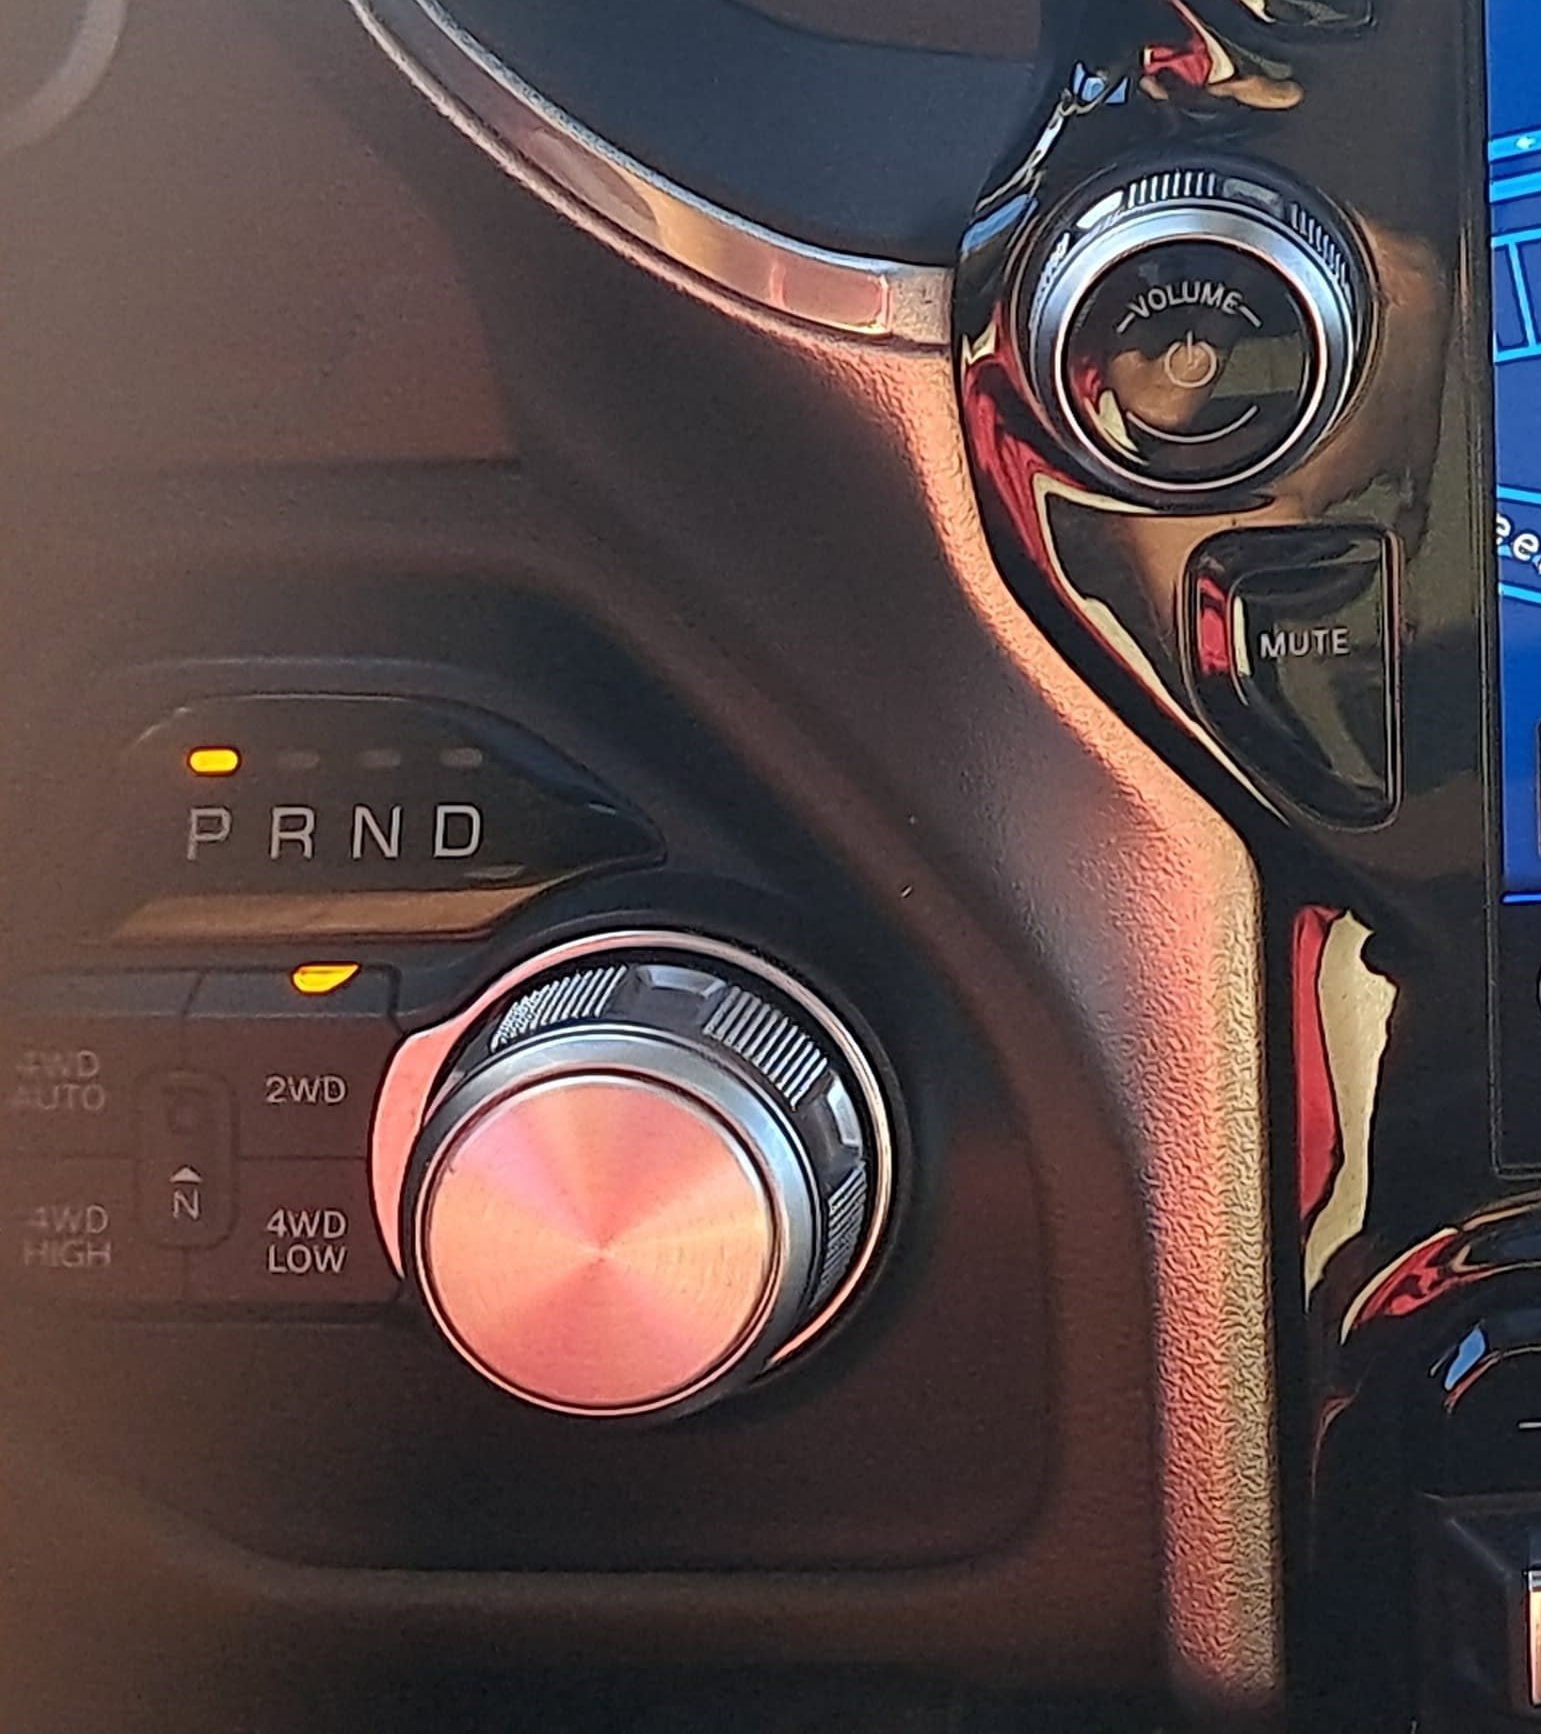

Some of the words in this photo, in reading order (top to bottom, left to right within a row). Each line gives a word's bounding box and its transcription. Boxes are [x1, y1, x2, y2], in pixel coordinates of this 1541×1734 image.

[1131, 280, 1242, 319] VOLUME
[1260, 627, 1349, 659] MUTE
[187, 808, 232, 861] P
[270, 806, 315, 860] R
[352, 806, 402, 859] N
[433, 804, 482, 858] D
[265, 1076, 347, 1103] 2WD
[172, 1187, 200, 1220] N
[265, 1208, 348, 1239] 4WD
[23, 1239, 112, 1268] HIGH
[267, 1246, 347, 1274] LOW
